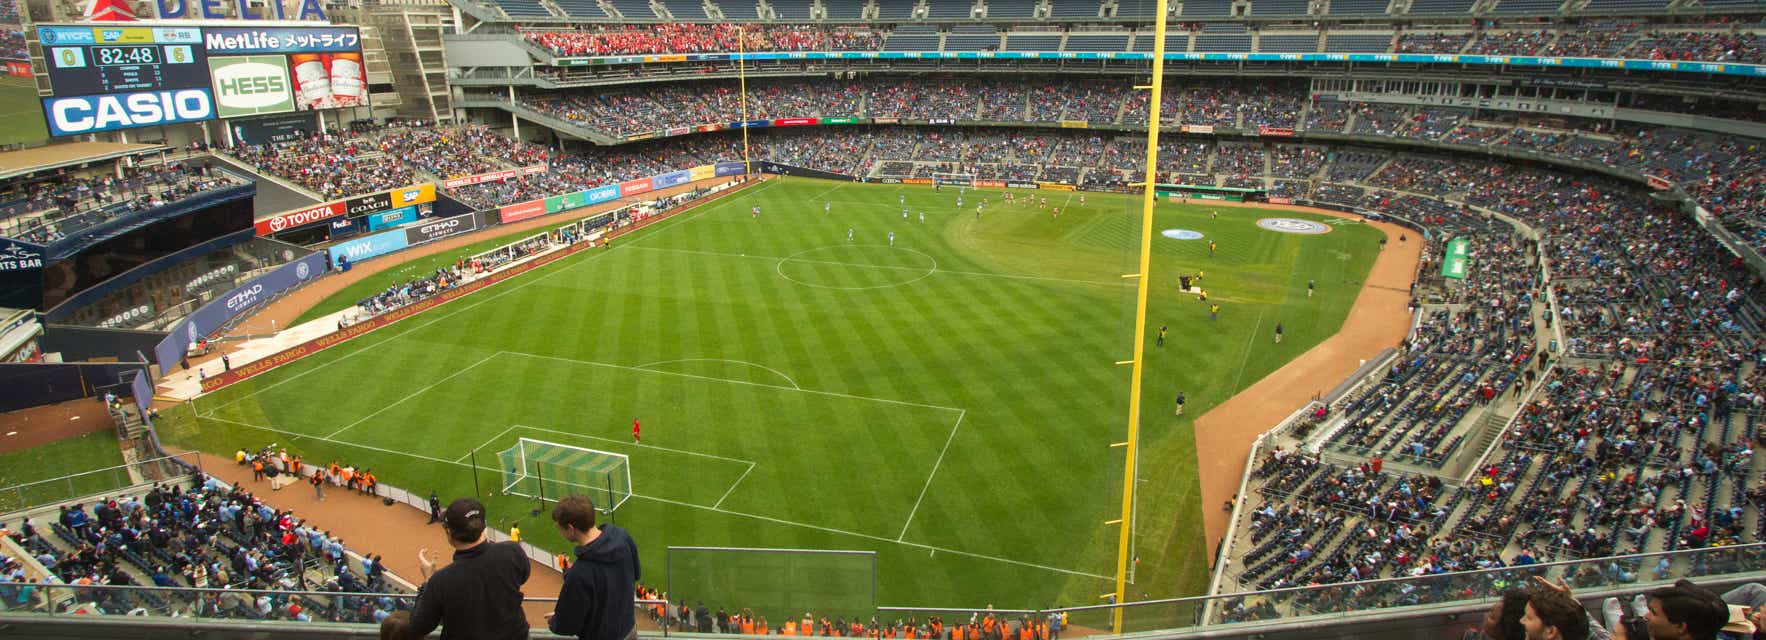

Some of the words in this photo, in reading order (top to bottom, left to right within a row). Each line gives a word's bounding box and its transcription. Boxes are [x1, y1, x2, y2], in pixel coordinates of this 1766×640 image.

[102, 30, 122, 41] SAP
[206, 31, 280, 50] MetLife
[285, 34, 358, 48] メットライフ
[63, 49, 76, 66] 0
[100, 48, 153, 64] 82:48
[173, 46, 185, 62] 6
[219, 75, 284, 97] HESS
[53, 90, 210, 132] CASIO
[403, 190, 420, 202] SAP
[350, 200, 389, 214] COACH
[287, 206, 334, 226] TOYOTA
[421, 219, 459, 234] ETIHAD
[20, 258, 42, 269] BAR
[227, 284, 263, 309] ETIHAD
[234, 359, 272, 377] WELLS
[274, 346, 306, 364] FARGO
